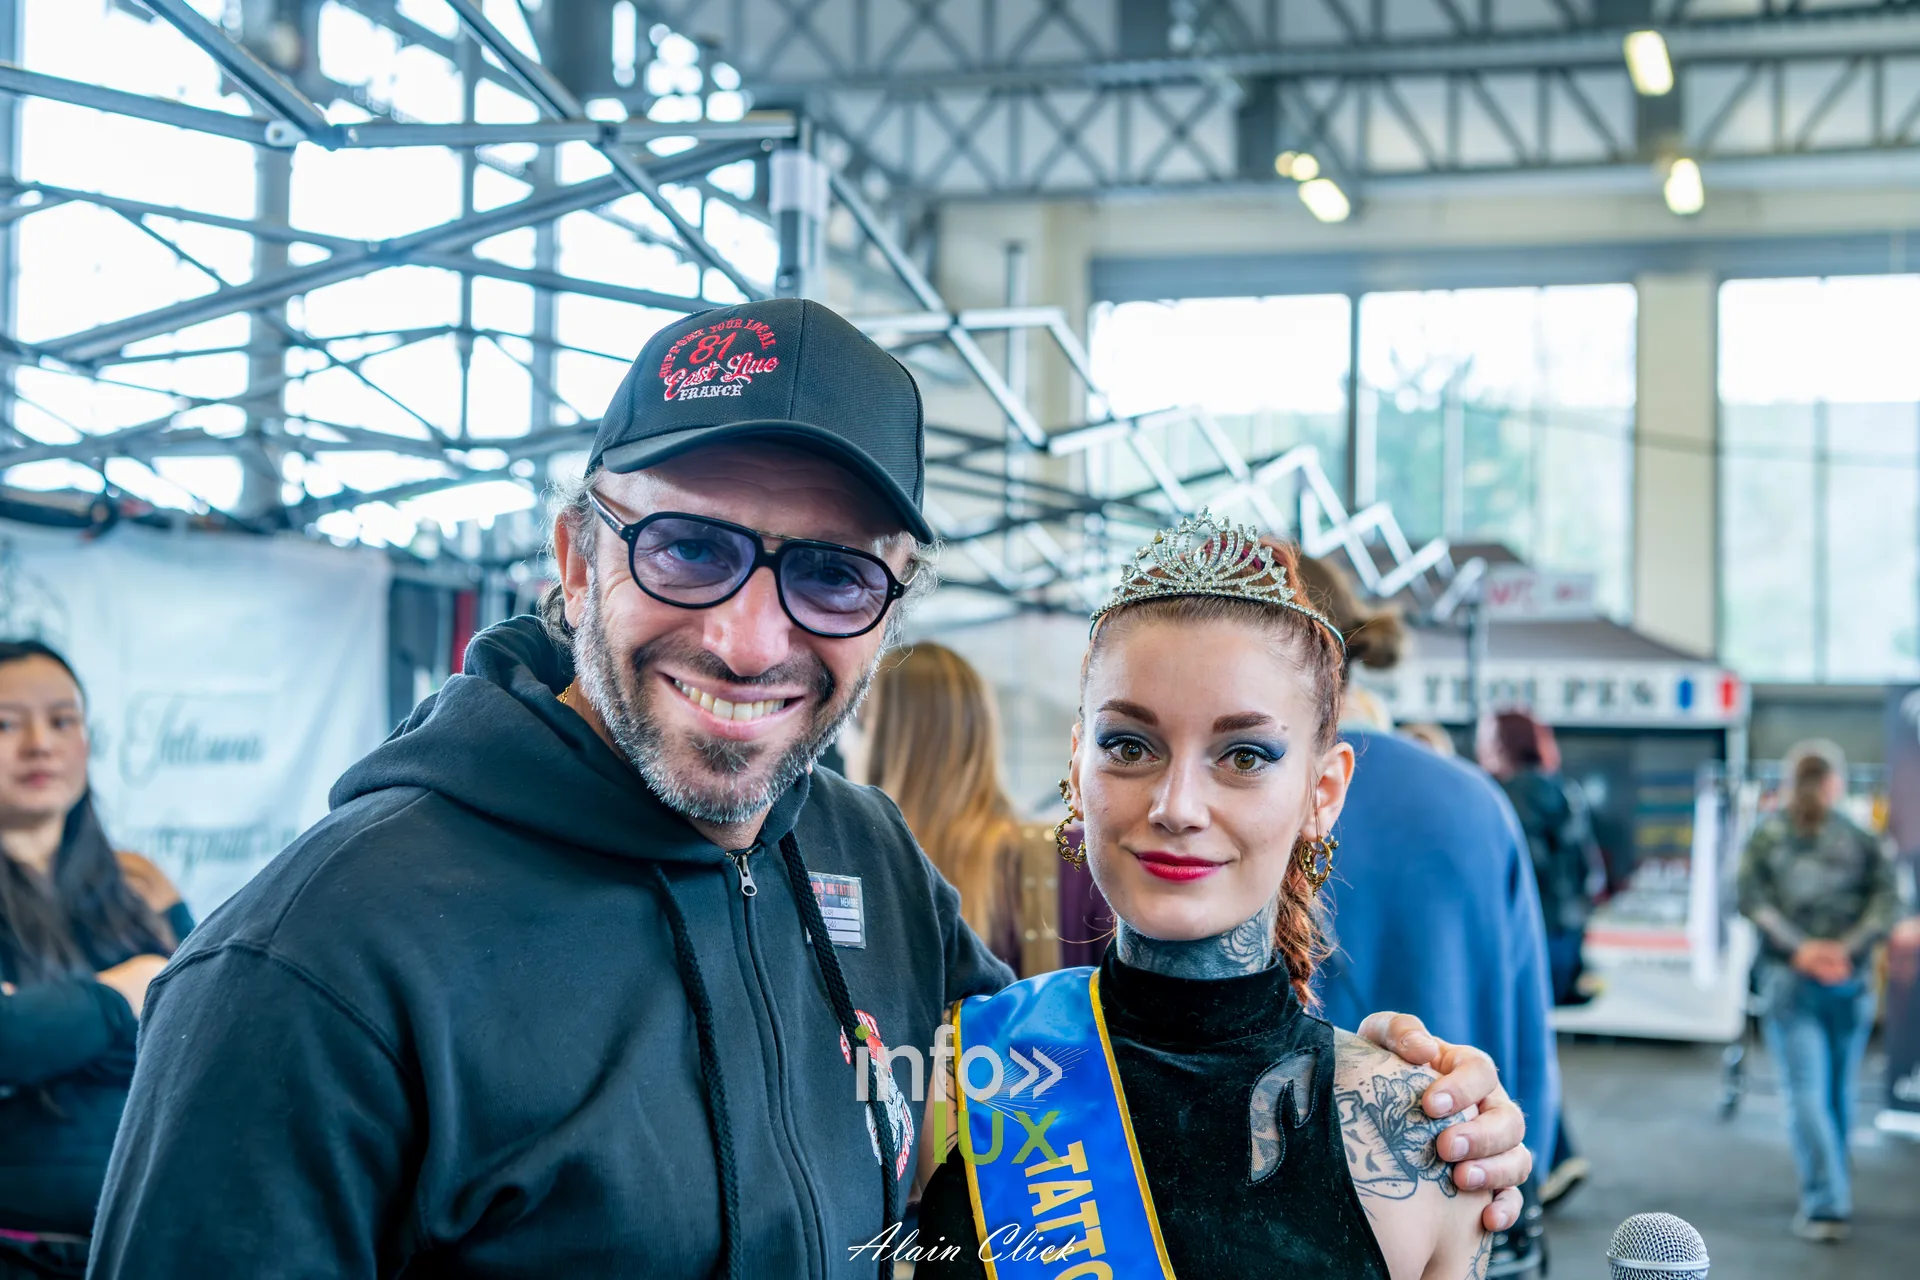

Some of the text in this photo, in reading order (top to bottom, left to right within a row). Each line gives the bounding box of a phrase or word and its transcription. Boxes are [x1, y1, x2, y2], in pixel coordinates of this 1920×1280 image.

[688, 331, 737, 365] 81
[708, 318, 743, 333] YOUR
[744, 318, 777, 351] LOCAL
[663, 351, 780, 401] East Line
[678, 384, 743, 401] FRANCE
